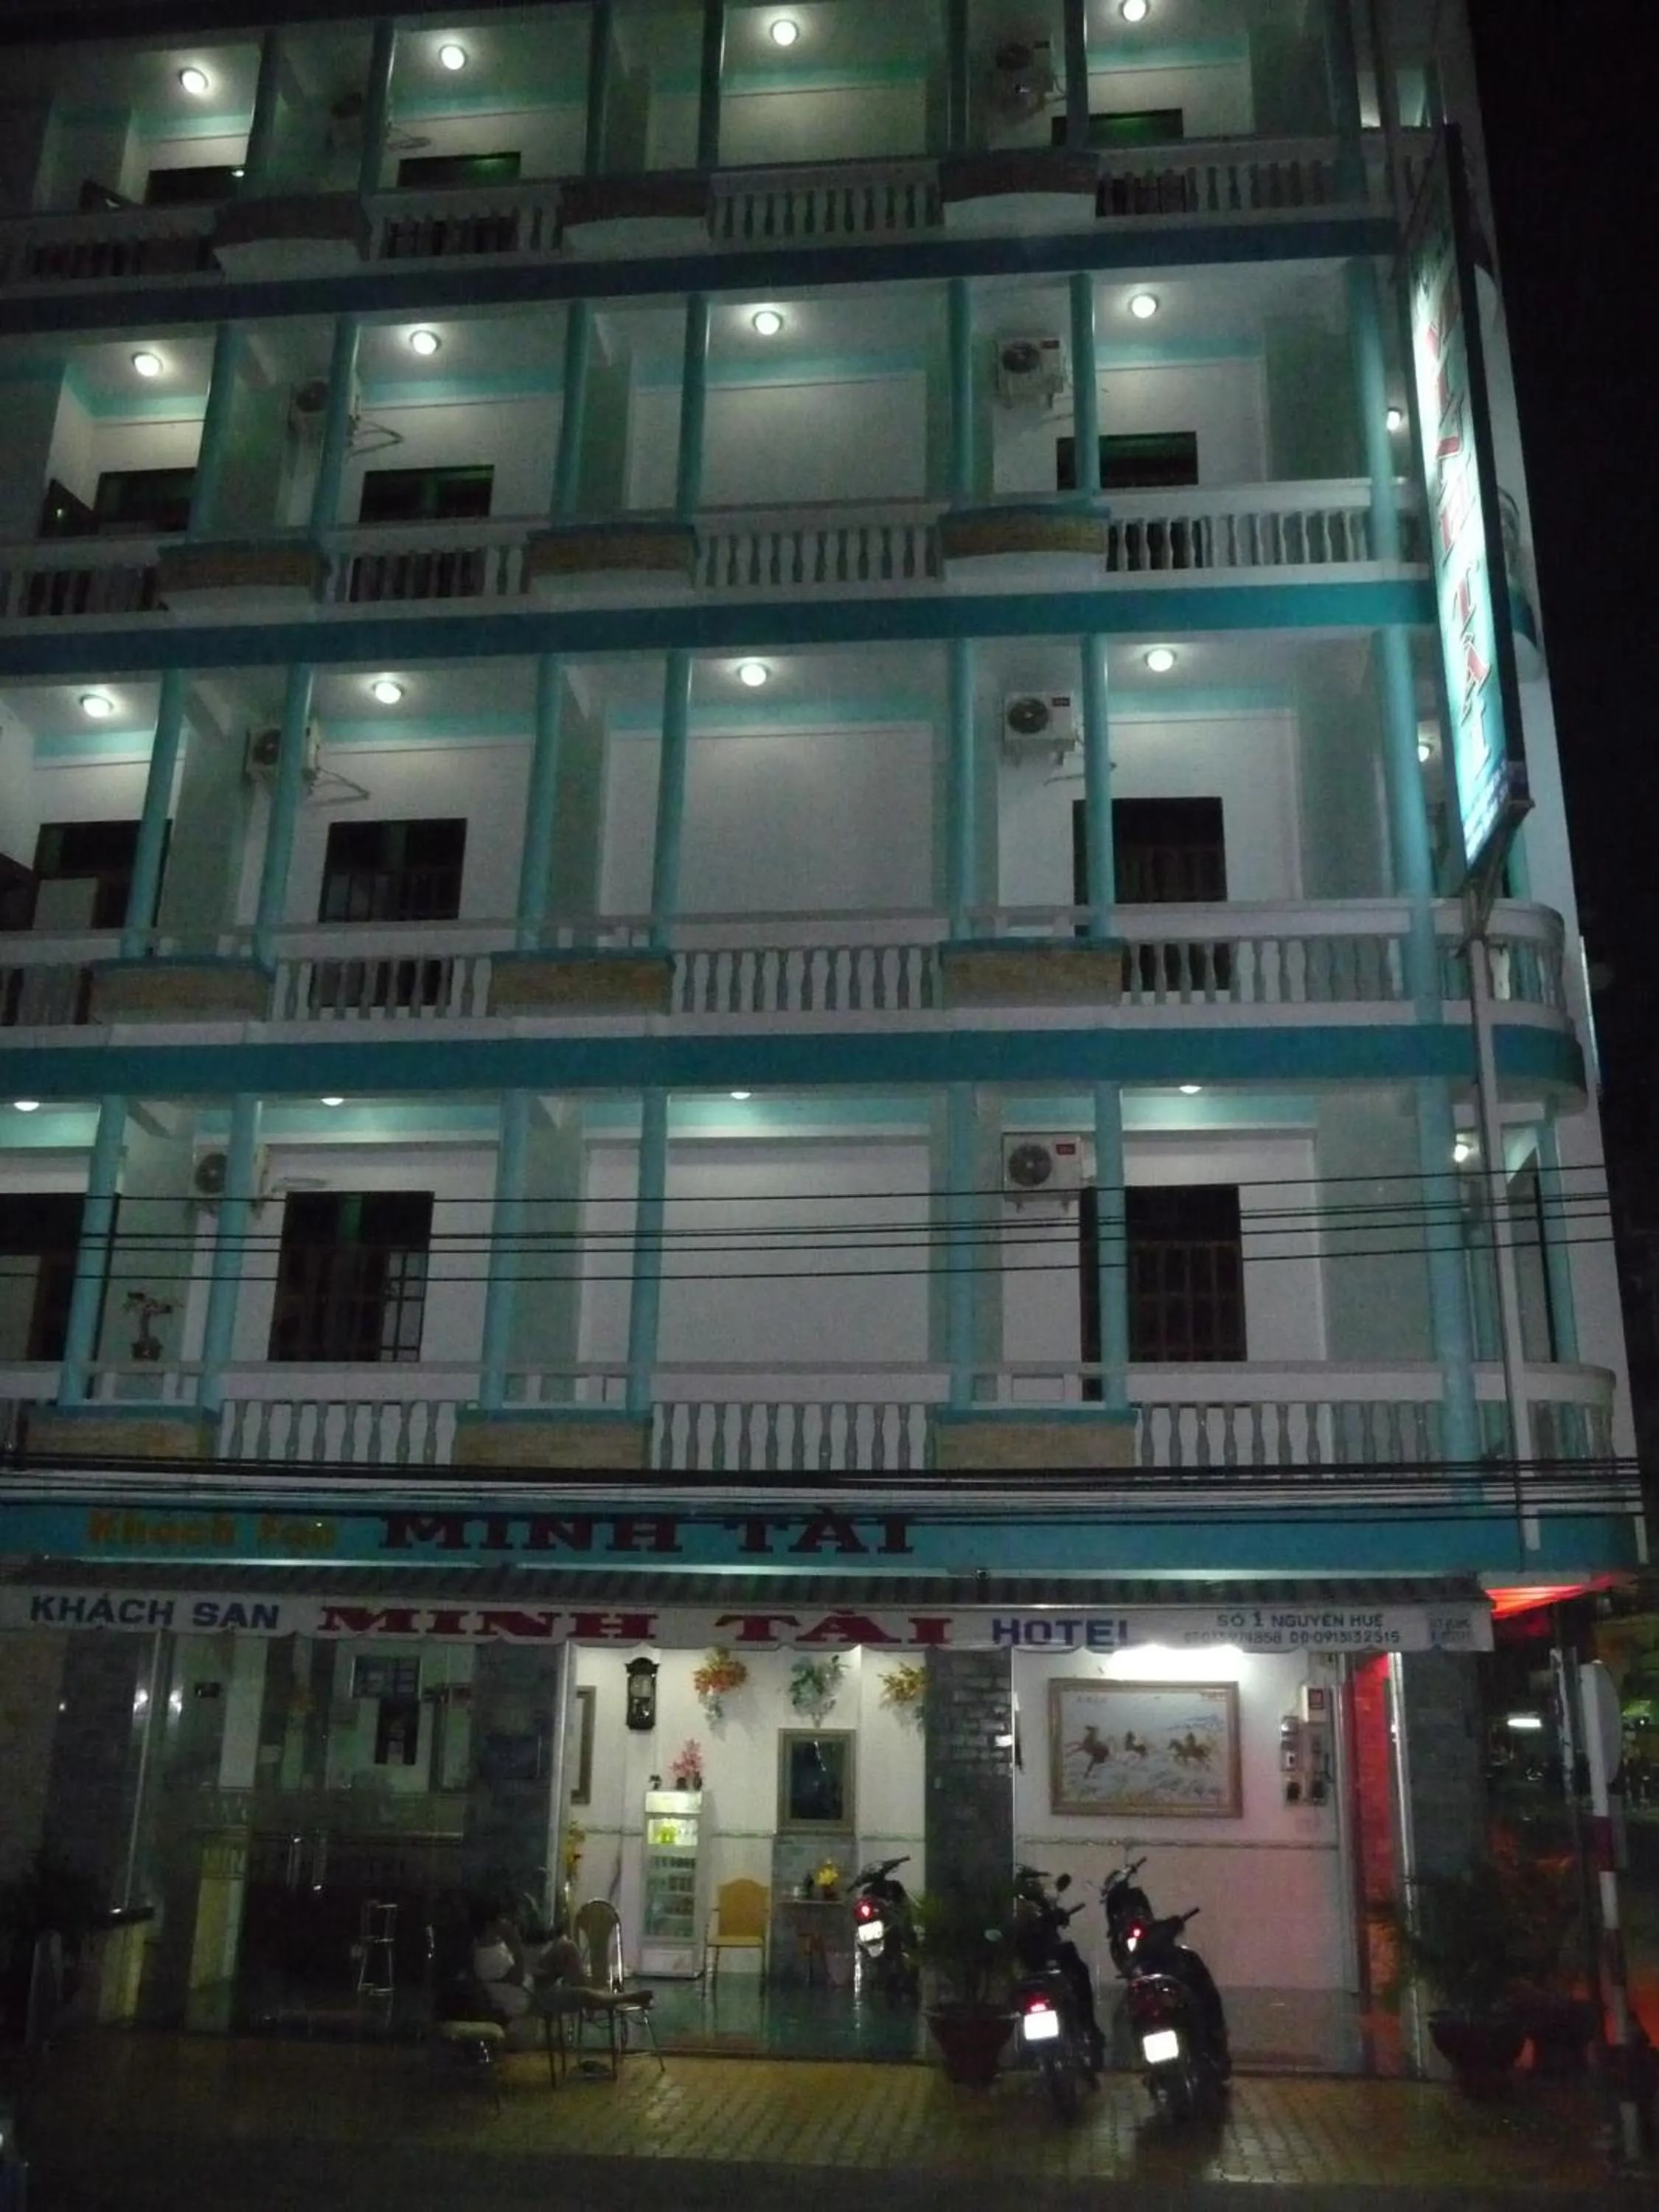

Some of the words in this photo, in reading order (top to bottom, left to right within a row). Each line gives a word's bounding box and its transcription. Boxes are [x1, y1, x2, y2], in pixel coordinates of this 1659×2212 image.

[378, 1511, 684, 1552] MINH
[317, 1605, 659, 1639] MINH
[1253, 1610, 1264, 1627] 1
